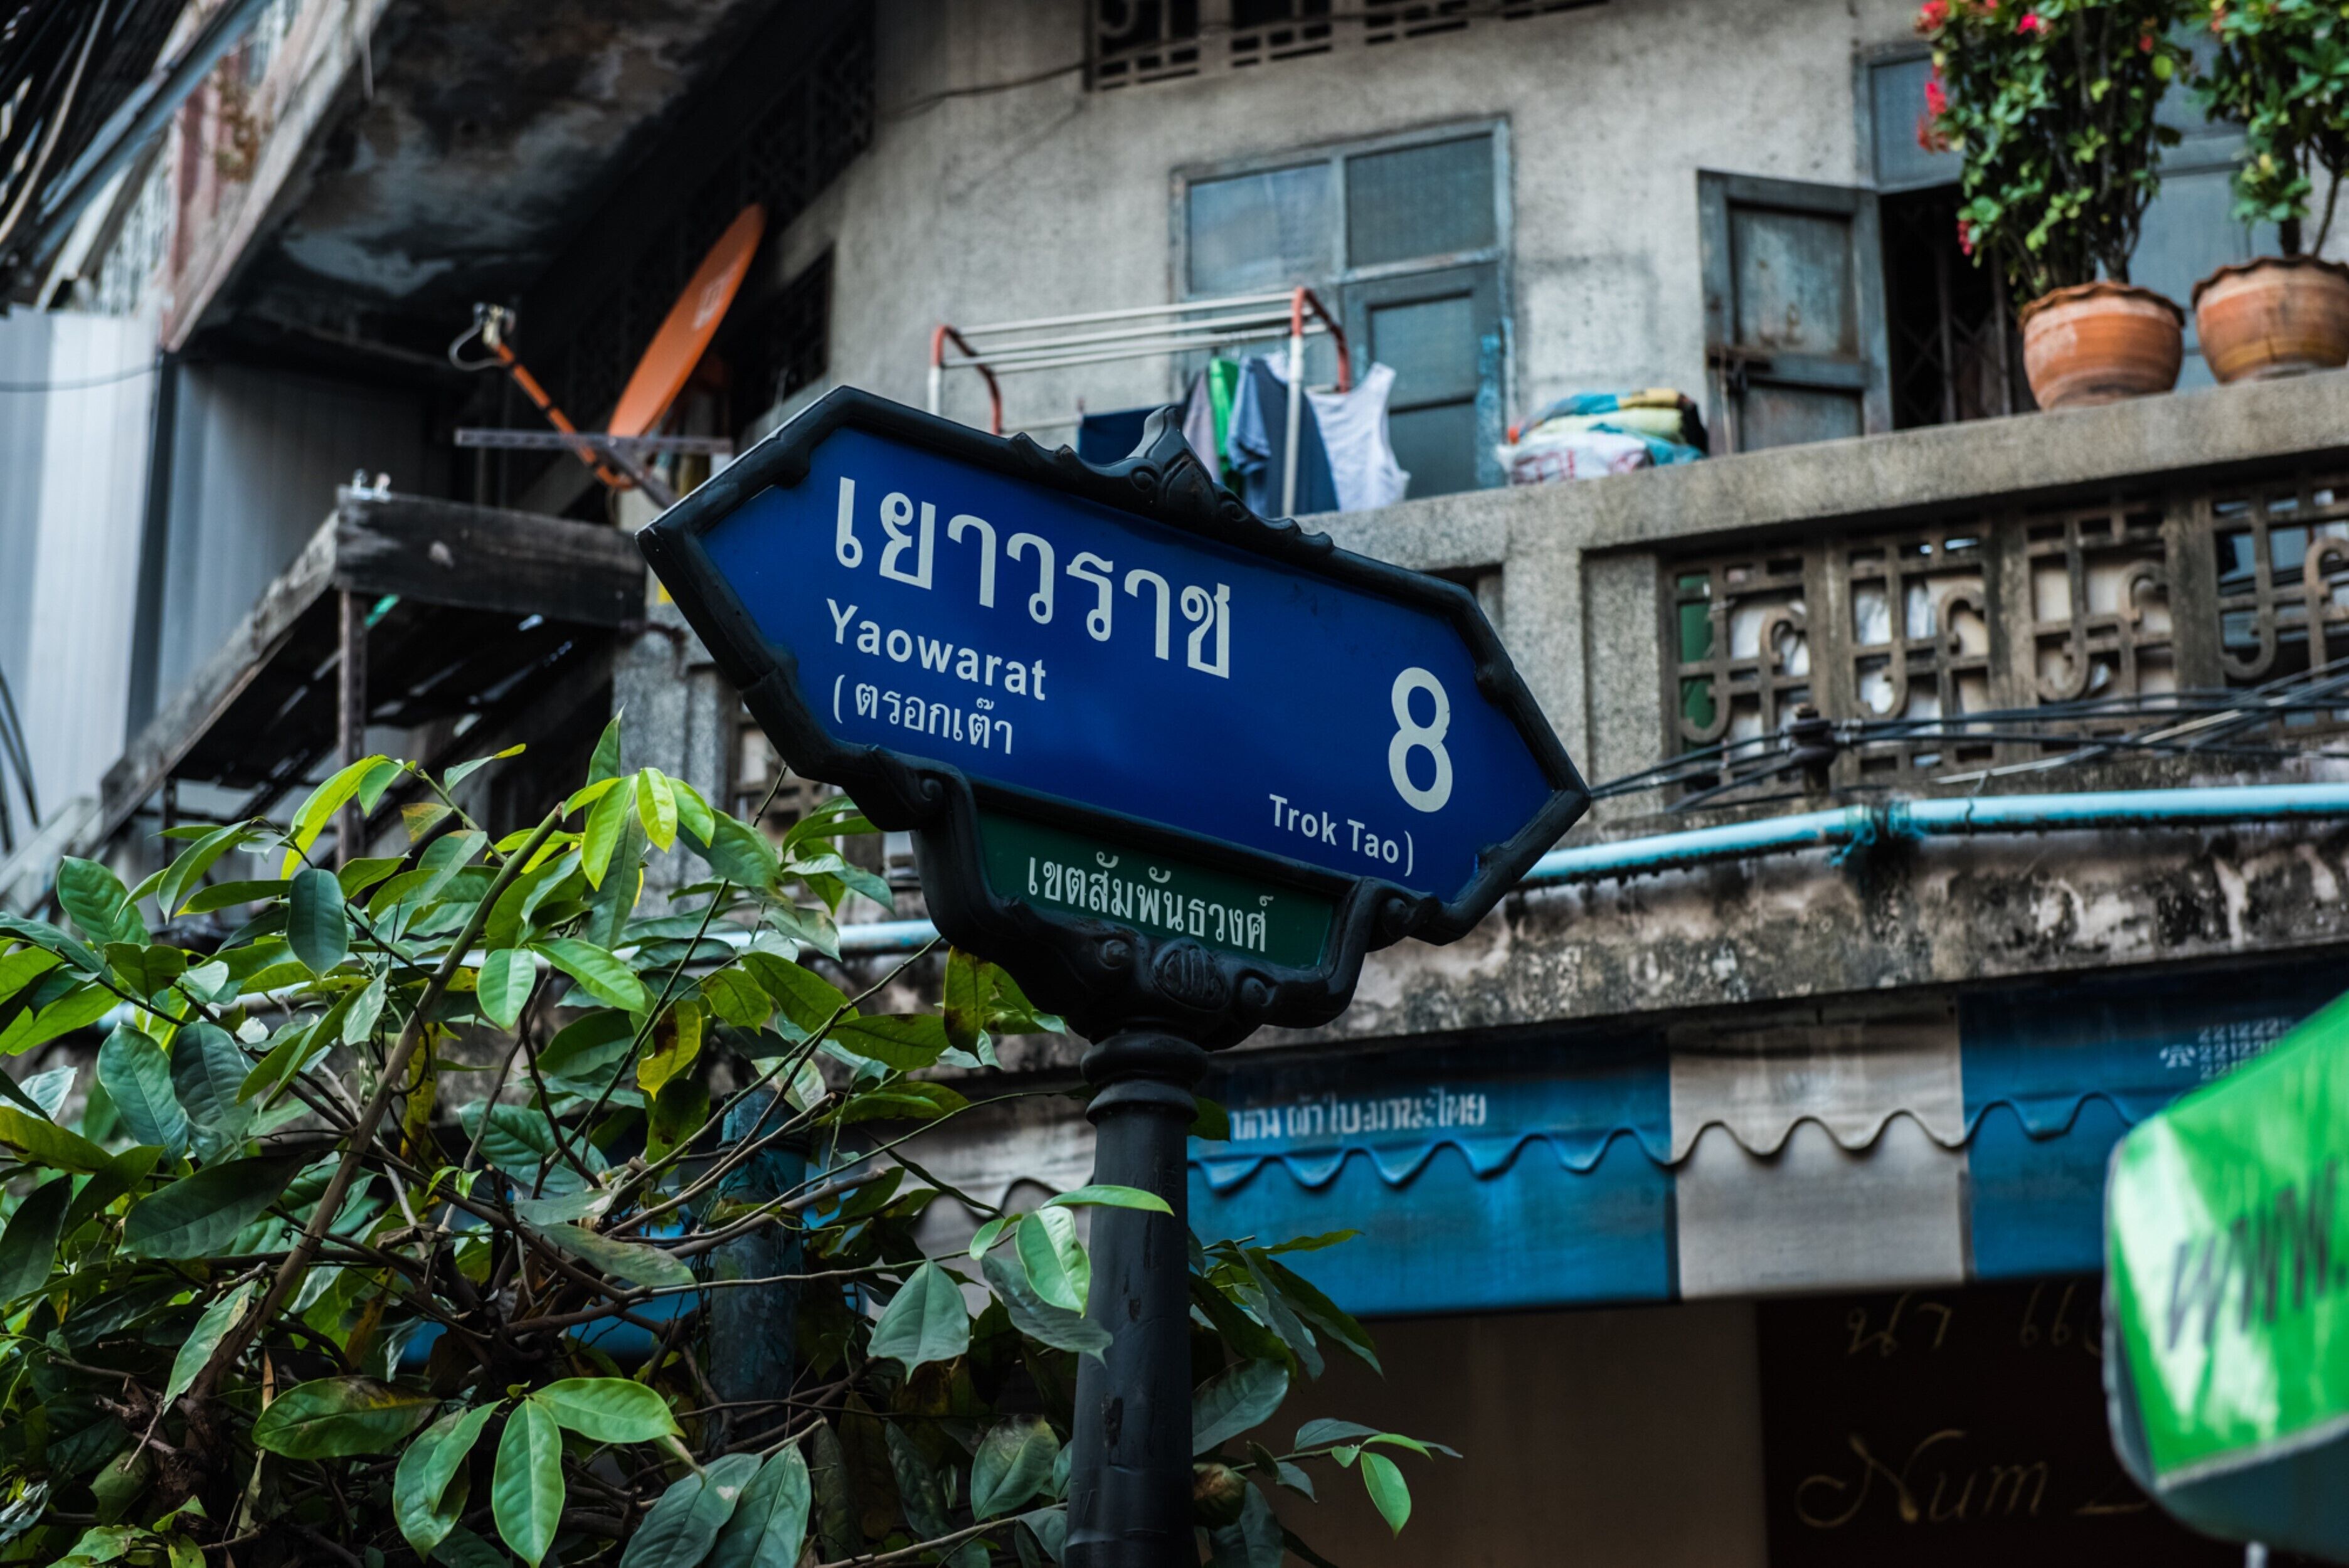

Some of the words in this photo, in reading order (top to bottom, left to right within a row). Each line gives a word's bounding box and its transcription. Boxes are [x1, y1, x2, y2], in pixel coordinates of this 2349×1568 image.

[835, 476, 1230, 679] เยาวราช
[826, 598, 1047, 701] Yaowarat
[1388, 667, 1453, 813] 8
[1269, 793, 1337, 845] Trok
[1347, 818, 1414, 877] Tao)
[1028, 851, 1275, 953] เขตสัมพันธวงศ์
[1794, 1428, 2050, 1530] Num
